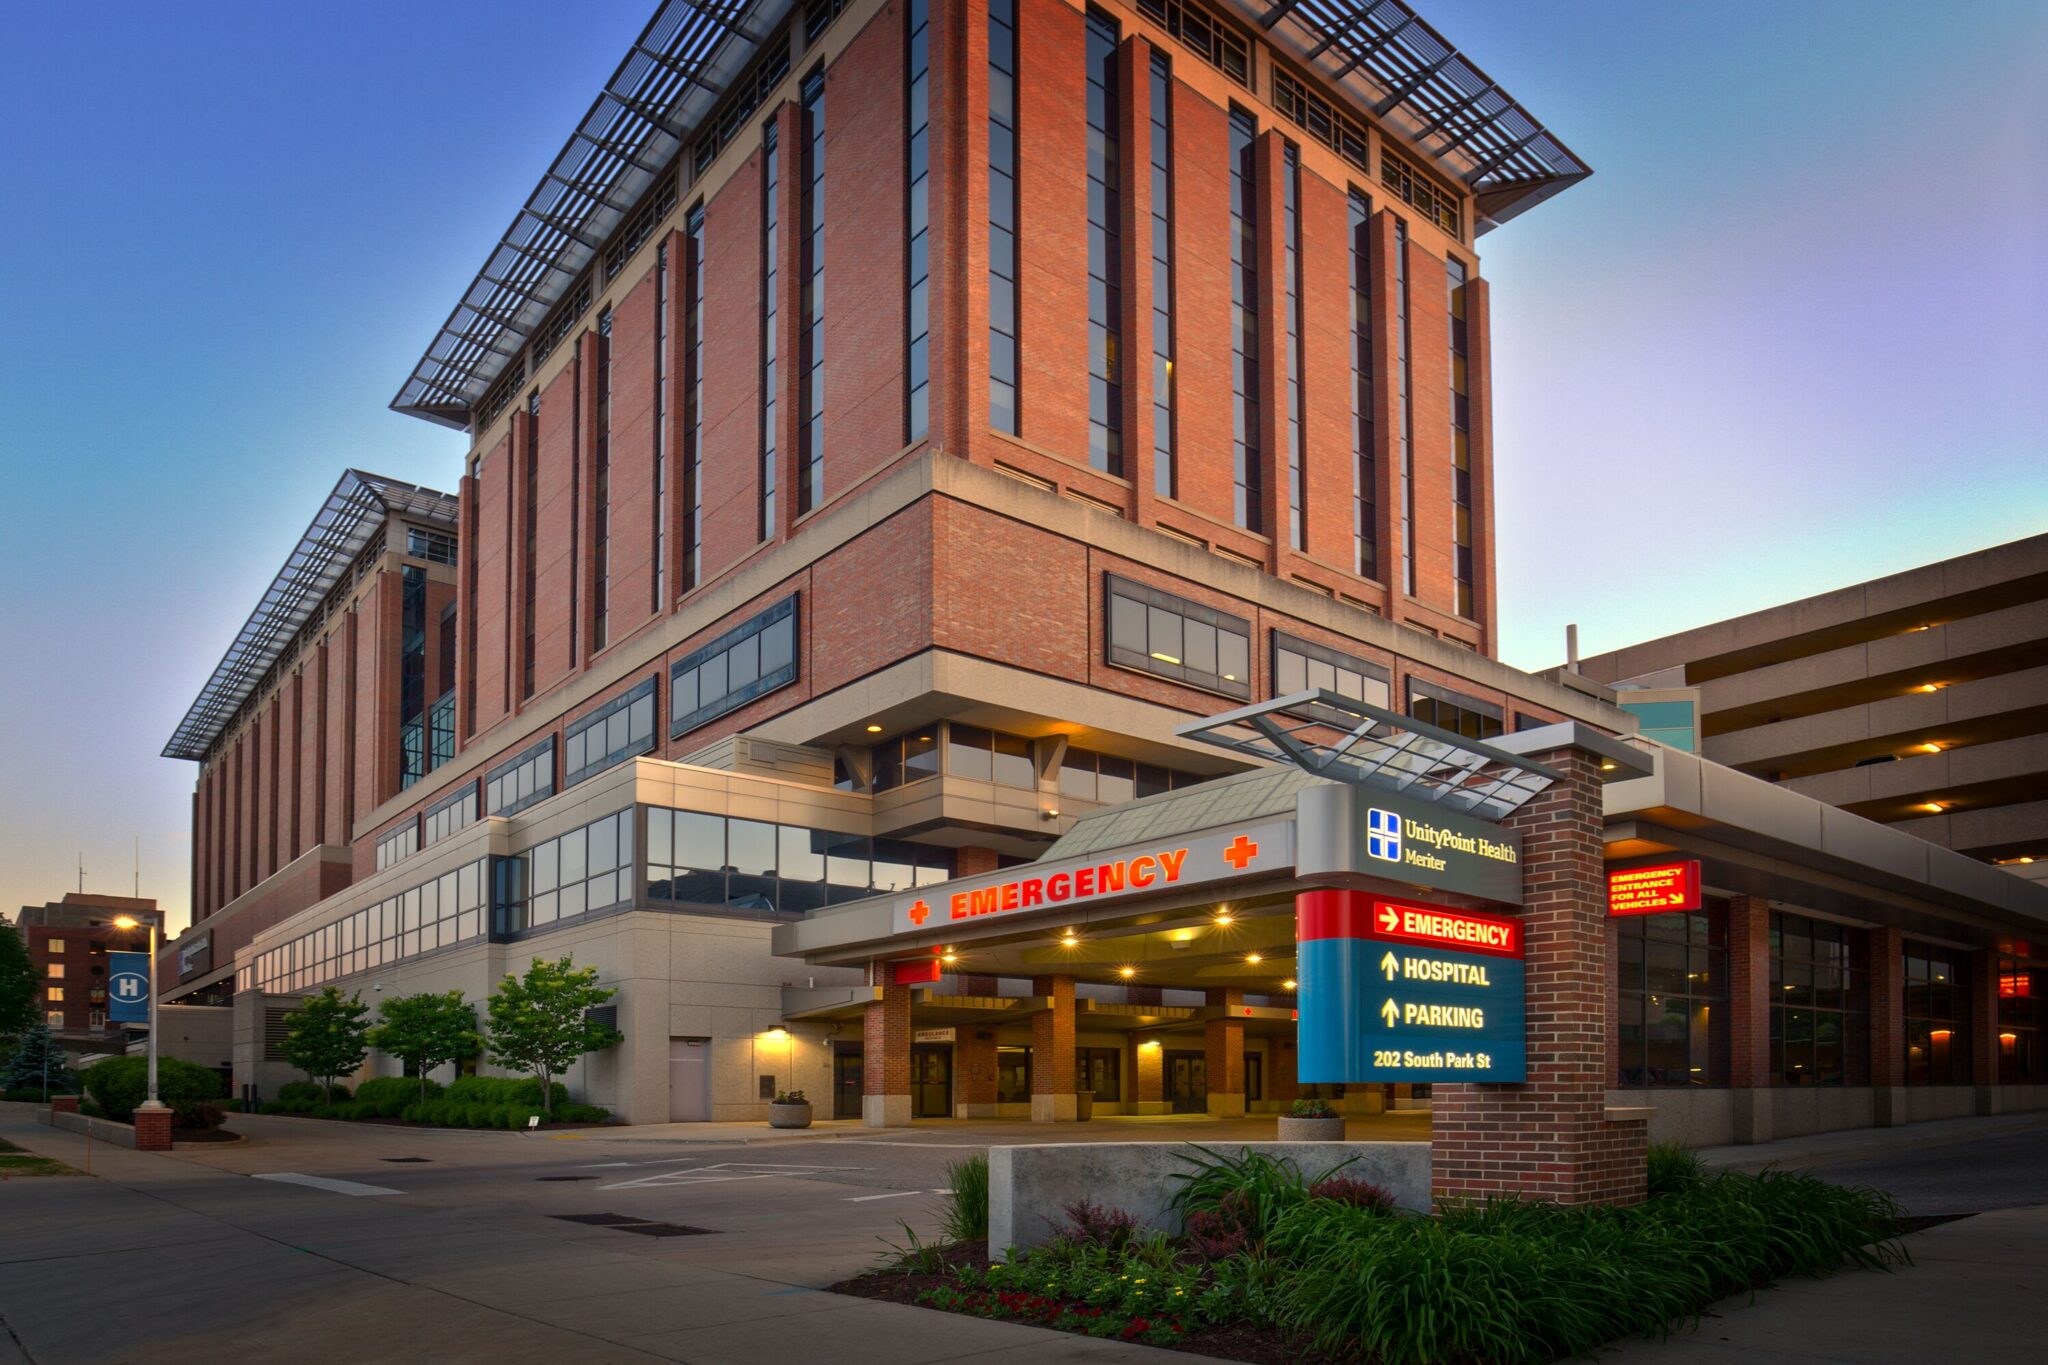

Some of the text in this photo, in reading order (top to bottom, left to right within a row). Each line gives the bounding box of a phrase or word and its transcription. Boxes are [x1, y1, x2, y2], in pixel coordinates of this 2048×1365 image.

[1404, 819, 1517, 864] UnityPoint Health
[1405, 848, 1447, 872] Meriter
[950, 848, 1190, 921] EMERGENCY
[1611, 868, 1683, 883] EMERGENCY
[1611, 878, 1674, 893] ENTRANCE
[1611, 889, 1660, 901] FOR ALL
[1611, 898, 1668, 911] VEHICLES
[1403, 911, 1510, 947] EMERGENCY
[1403, 957, 1491, 987] HOSPITAL
[119, 978, 139, 997] H
[1403, 1003, 1484, 1029] PARKING
[1373, 1050, 1492, 1070] 202 South Park St
